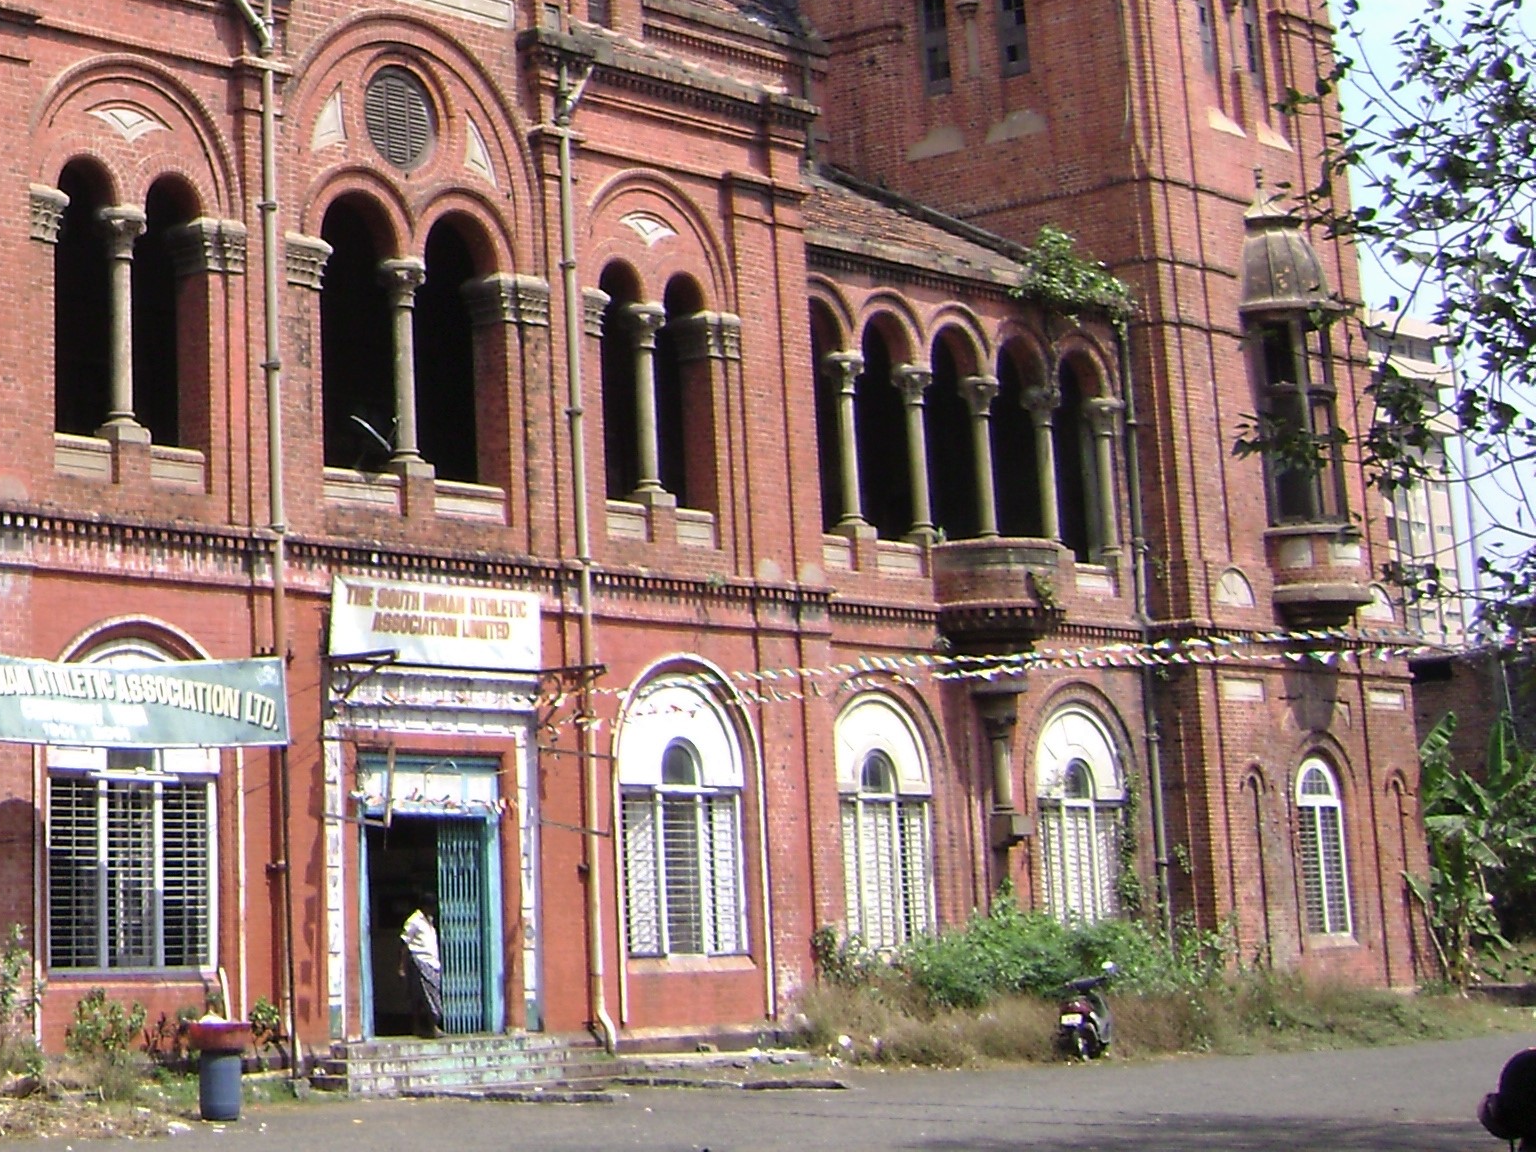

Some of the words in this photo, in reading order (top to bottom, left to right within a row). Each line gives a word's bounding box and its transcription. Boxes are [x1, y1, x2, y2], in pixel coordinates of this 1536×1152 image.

[345, 583, 374, 606] THE
[377, 587, 420, 611] SOUTH
[423, 592, 465, 614] INDIAN
[470, 597, 526, 618] ATHLETIC
[372, 611, 457, 637] ASSOCIATION
[462, 619, 510, 639] LIMITED
[32, 666, 116, 701] ATHLETIC
[115, 673, 241, 720] ASSOCIATION
[245, 691, 280, 732] LTD.
